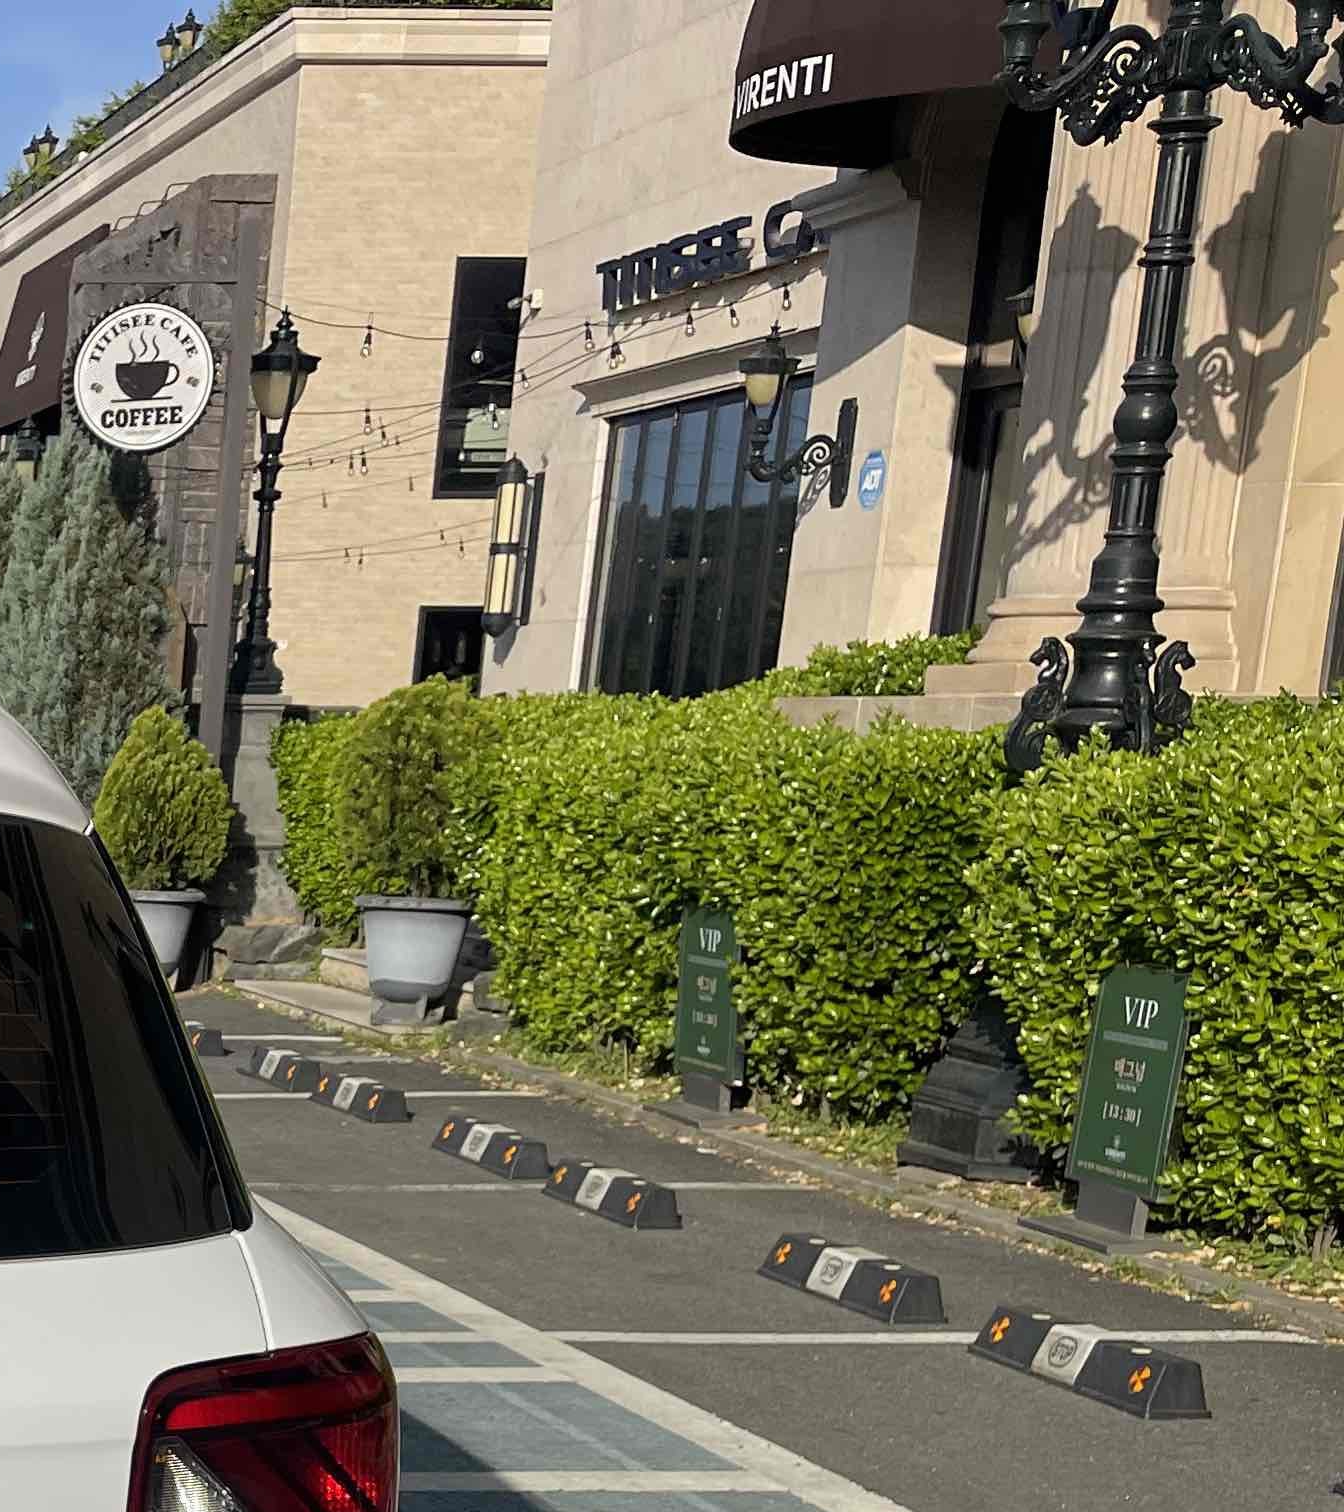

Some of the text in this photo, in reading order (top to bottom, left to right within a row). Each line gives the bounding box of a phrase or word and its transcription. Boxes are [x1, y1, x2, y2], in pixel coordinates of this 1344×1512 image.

[736, 53, 833, 119] VIRENTI
[89, 314, 199, 364] TITISEE CAFE
[101, 405, 183, 429] COFFEE
[699, 927, 721, 953] VIP
[1125, 996, 1159, 1029] VIP
